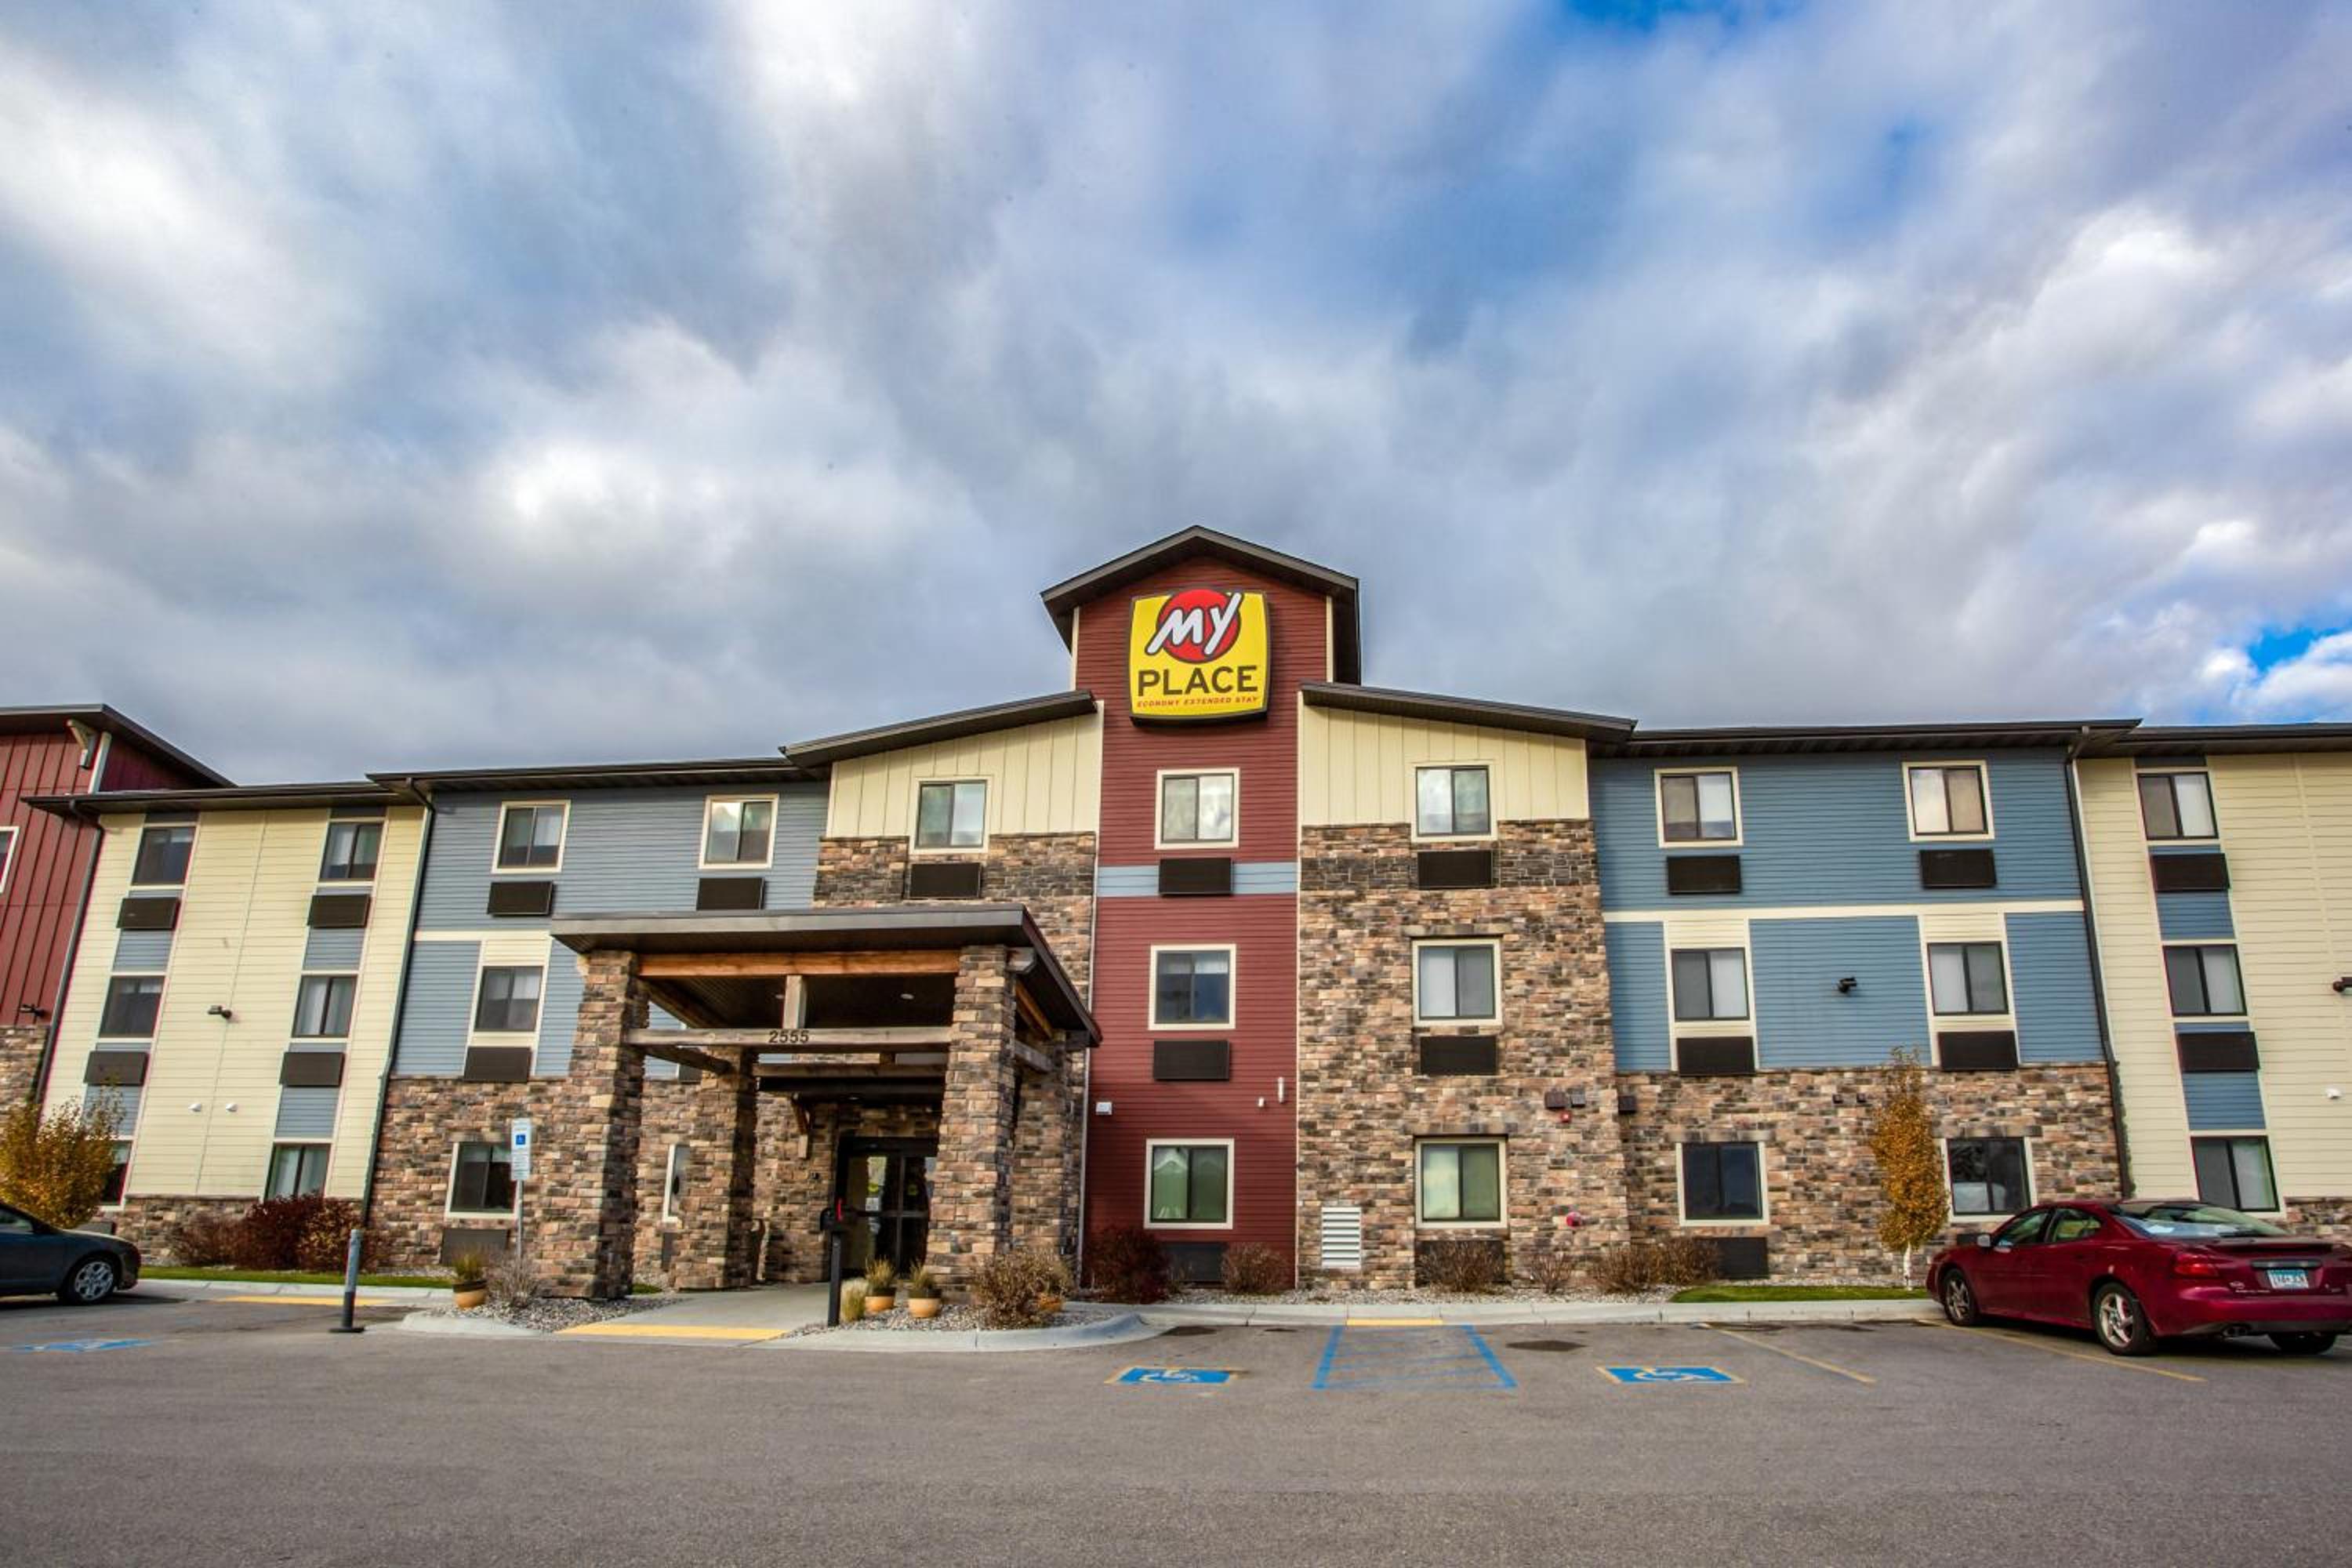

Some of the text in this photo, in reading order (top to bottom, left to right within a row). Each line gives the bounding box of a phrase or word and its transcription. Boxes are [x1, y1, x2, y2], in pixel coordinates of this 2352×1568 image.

[1138, 665, 1258, 696] PLACE
[1137, 699, 1180, 707] ECONOMY
[1184, 696, 1231, 705] EXTENDED
[768, 1029, 809, 1044] 2555
